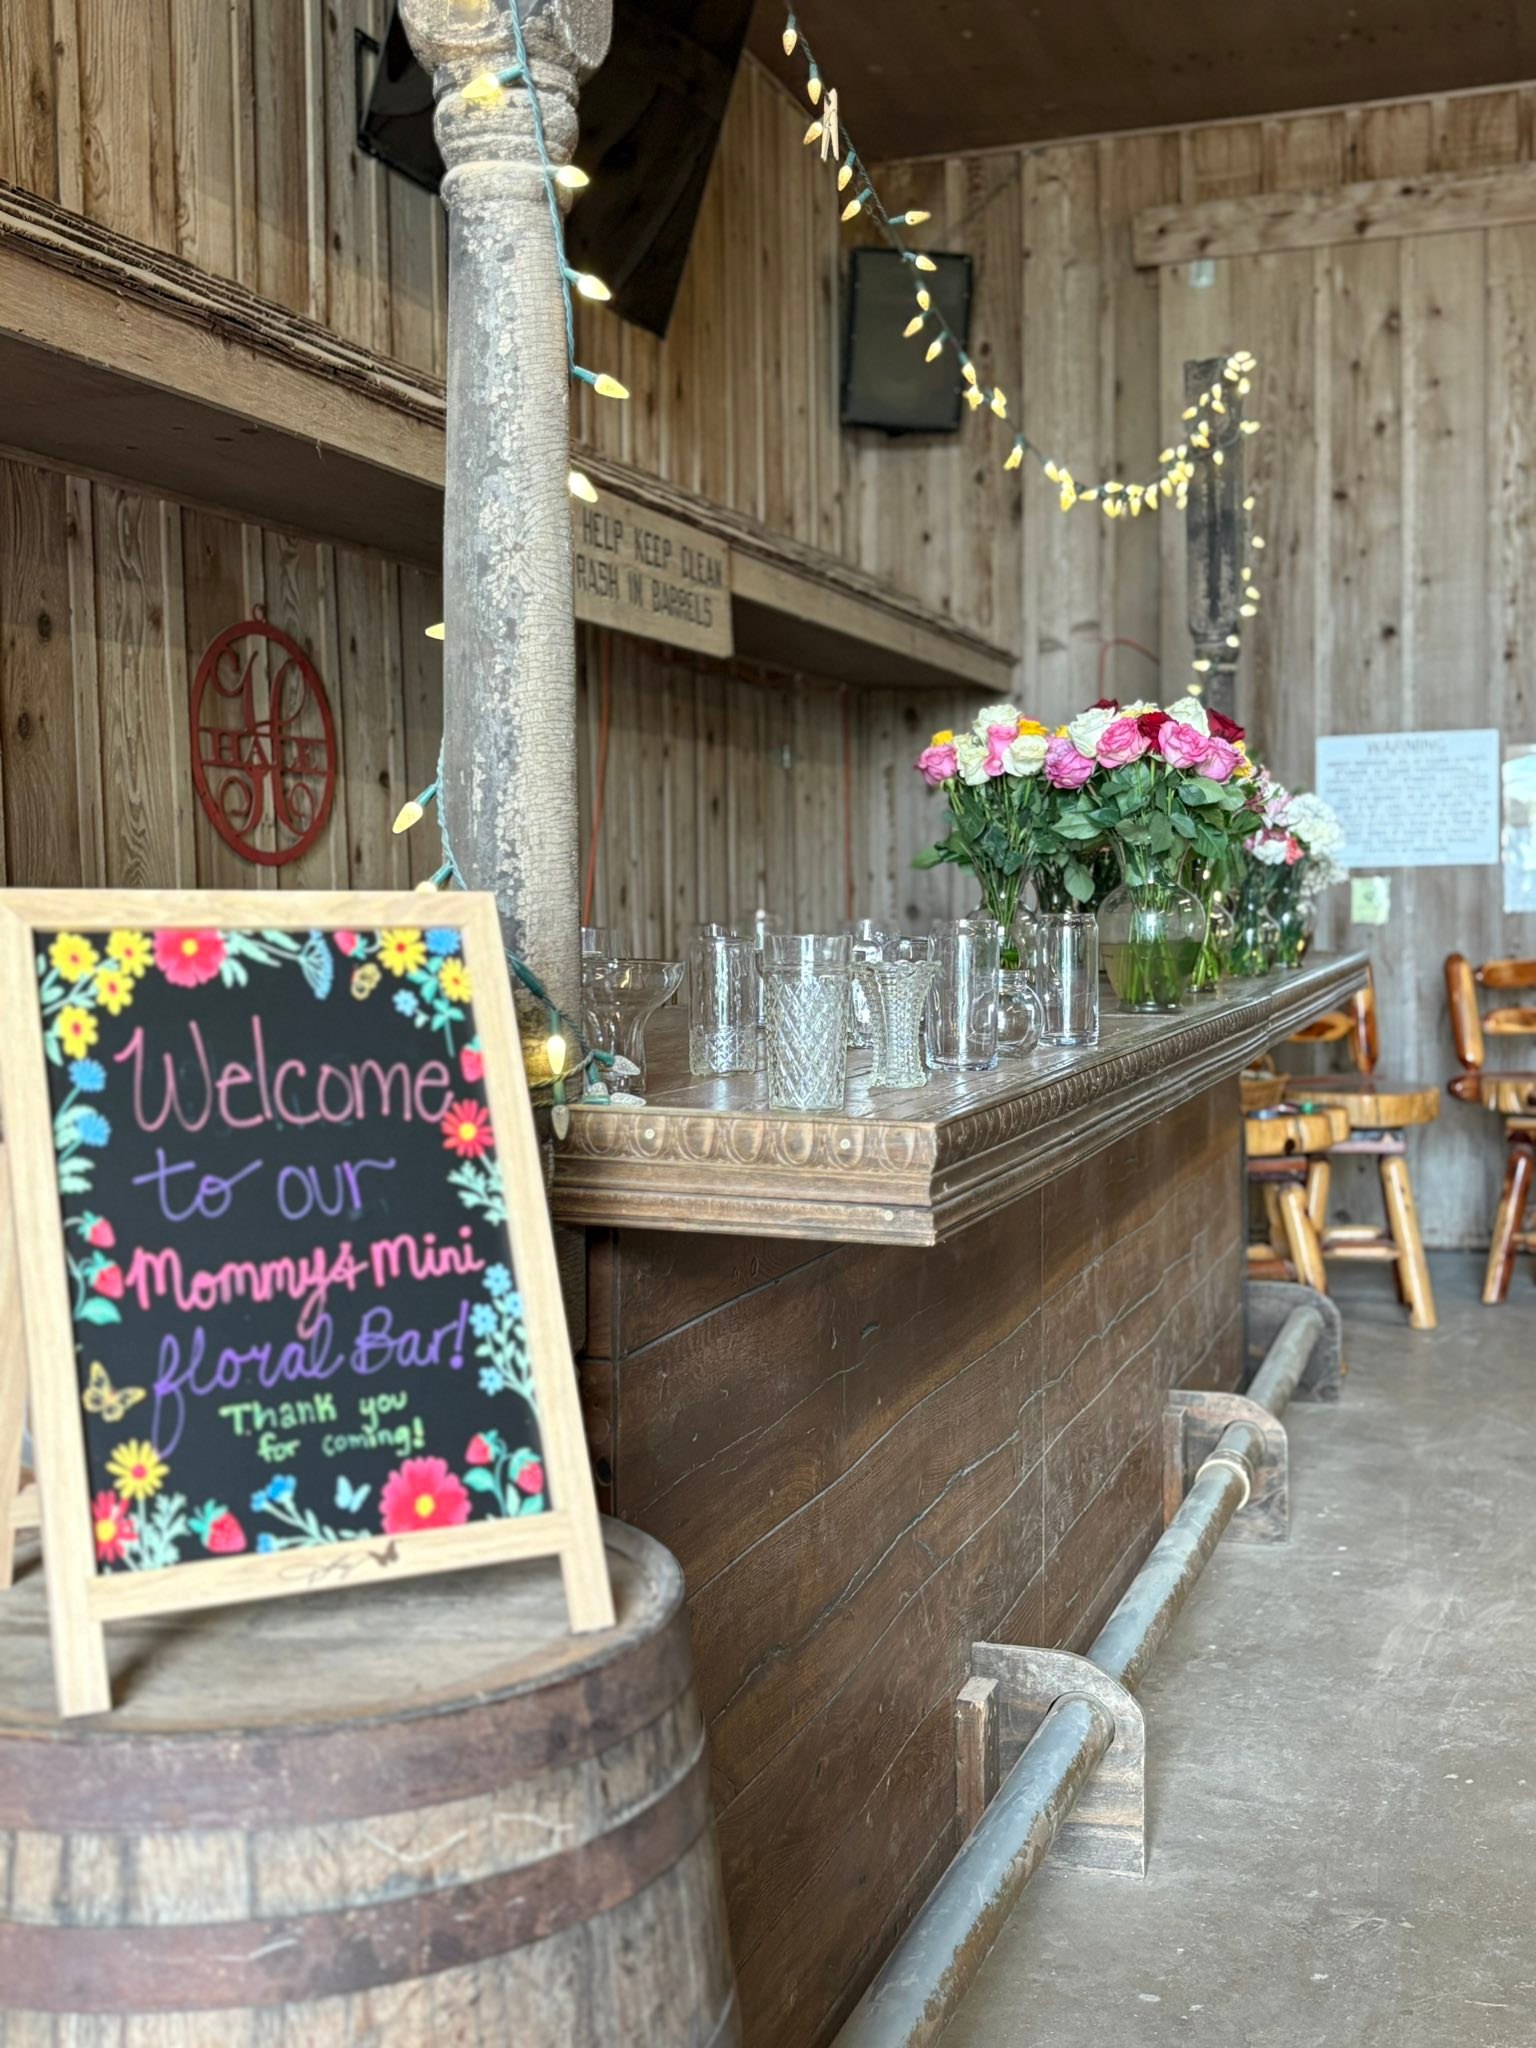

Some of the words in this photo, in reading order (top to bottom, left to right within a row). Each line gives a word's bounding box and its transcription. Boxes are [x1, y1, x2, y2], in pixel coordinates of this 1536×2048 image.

[582, 507, 623, 554] HELP
[634, 527, 672, 569] KEEP
[681, 545, 723, 588] CLEAN
[575, 553, 620, 600] RASH
[628, 570, 643, 609] IN
[652, 579, 713, 628] BARRELS
[113, 1014, 454, 1132] Welcome
[131, 1147, 264, 1222] to
[277, 1157, 397, 1221] our
[370, 1225, 485, 1288] Mini
[151, 1313, 345, 1461] floral
[350, 1299, 469, 1371] Bar!
[218, 1393, 338, 1436] Thank
[358, 1390, 408, 1432] you
[257, 1432, 300, 1463] for
[321, 1416, 425, 1458] coming!
